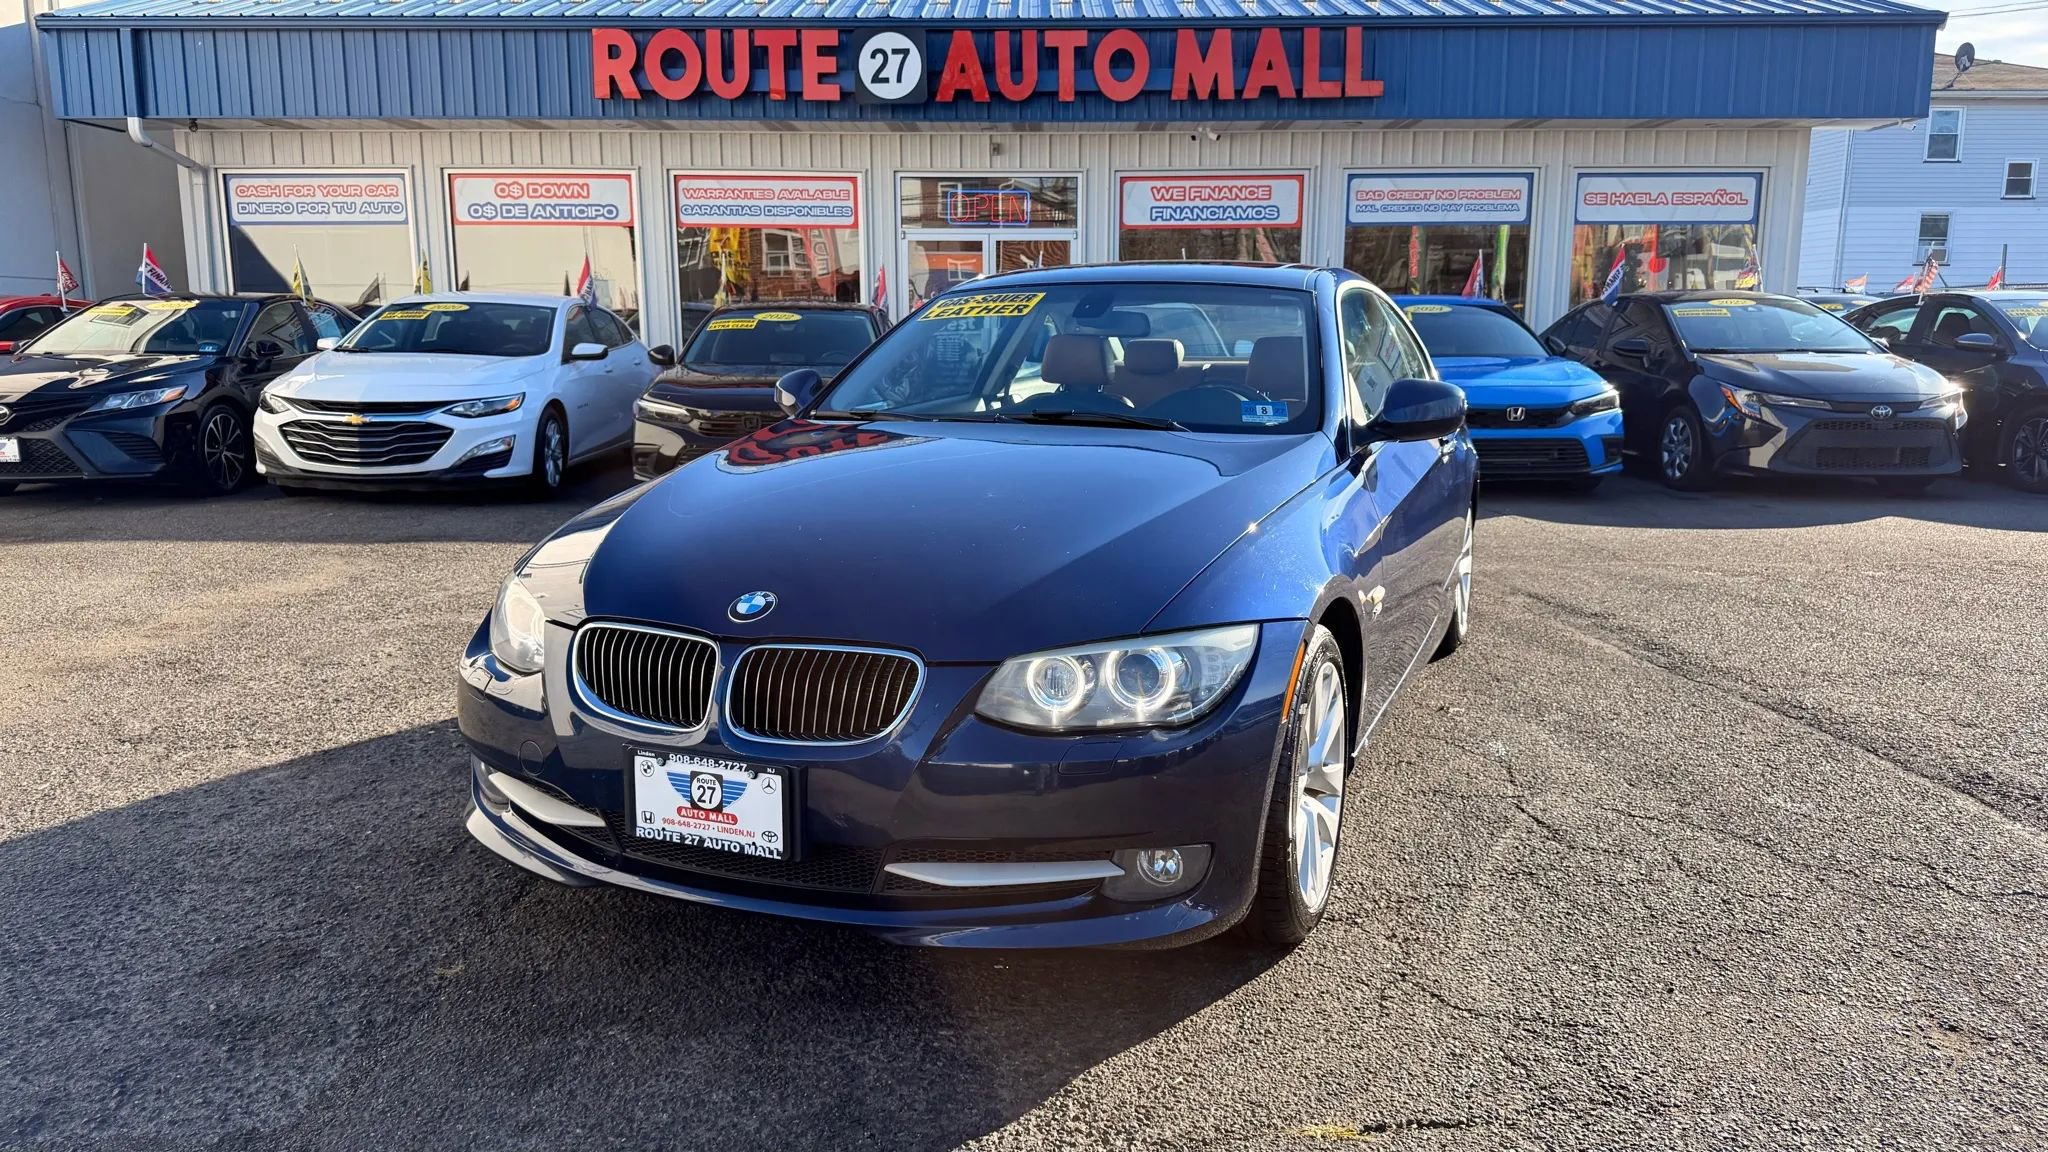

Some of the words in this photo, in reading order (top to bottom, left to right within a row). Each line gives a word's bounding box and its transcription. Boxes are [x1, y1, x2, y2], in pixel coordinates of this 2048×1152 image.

[592, 28, 841, 100] ROUTE
[870, 47, 911, 84] 27
[935, 28, 1150, 102] AUTO
[1170, 26, 1384, 100] MALL
[236, 185, 280, 198] CASH
[283, 185, 315, 198] FOR
[319, 185, 362, 198] YOUR
[365, 184, 399, 198] CAR
[527, 183, 590, 199] DOWN
[682, 187, 774, 200] WARRANTIES
[776, 189, 850, 201] AVAILABLE
[1151, 186, 1186, 201] WE
[1188, 185, 1272, 201] FINANCE
[1356, 189, 1385, 201] BAD
[1386, 189, 1434, 201] CREDIT
[1435, 189, 1457, 201] NO
[1458, 189, 1521, 200] PROBLEM
[1584, 192, 1609, 206] SE
[1610, 192, 1668, 206] HABLA
[1671, 188, 1748, 206] ESPAÑOL
[238, 202, 294, 215] DINERO
[296, 202, 331, 215] POR
[333, 202, 356, 214] TU
[360, 202, 404, 214] AUTO
[500, 204, 528, 219] DE
[530, 204, 619, 220] ANTICIPO
[680, 204, 761, 216] GARANTIAS
[763, 205, 853, 217] DISPONIBLES
[951, 194, 1027, 222] OPEN
[1150, 205, 1280, 221] FINANCIAMOS
[1356, 204, 1379, 213] MAL
[1380, 203, 1423, 213] CREDITO
[1424, 203, 1440, 213] NO
[1441, 203, 1463, 213] HAY
[1464, 203, 1520, 212] PROBLEMA
[937, 293, 1039, 308] GAS-SAVER
[920, 304, 1030, 319] LEATHER
[1261, 406, 1268, 415] 8
[637, 749, 656, 757] Linden
[669, 754, 747, 772] 908-648-2727
[696, 777, 717, 786] ROUTE
[697, 784, 717, 805] 27
[680, 808, 706, 820] AUTO
[708, 812, 735, 824] MALL
[662, 817, 711, 831] 908-648-2727
[636, 827, 681, 843] ROUTE
[684, 834, 700, 846] 27
[704, 837, 740, 853] AUTO
[745, 844, 782, 860] MALL
